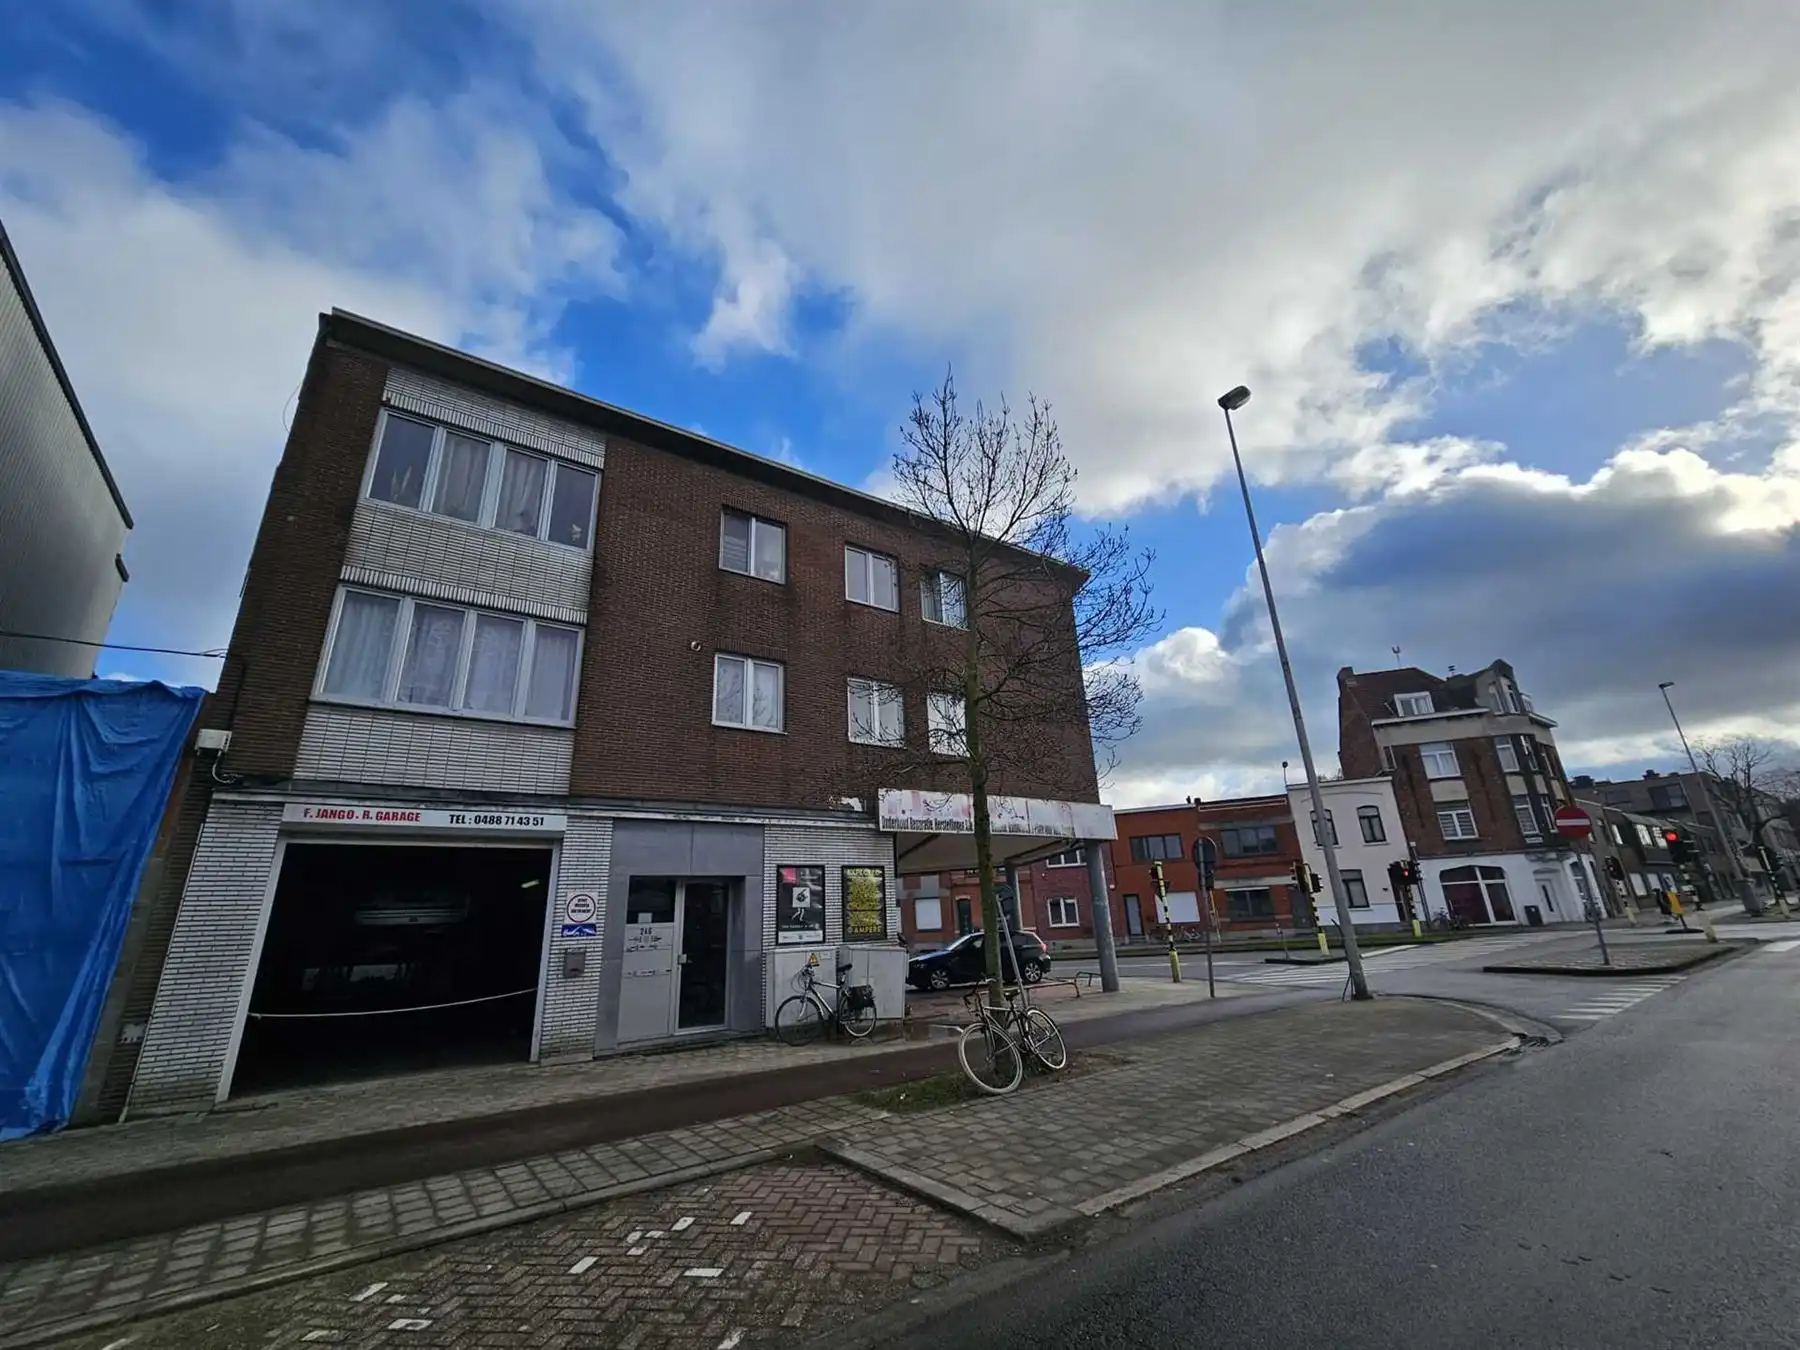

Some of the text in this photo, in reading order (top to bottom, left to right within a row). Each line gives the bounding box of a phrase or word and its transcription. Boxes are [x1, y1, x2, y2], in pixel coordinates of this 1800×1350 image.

[304, 808, 313, 818] F.
[375, 811, 421, 822] GARAGE
[474, 815, 502, 825] 0488
